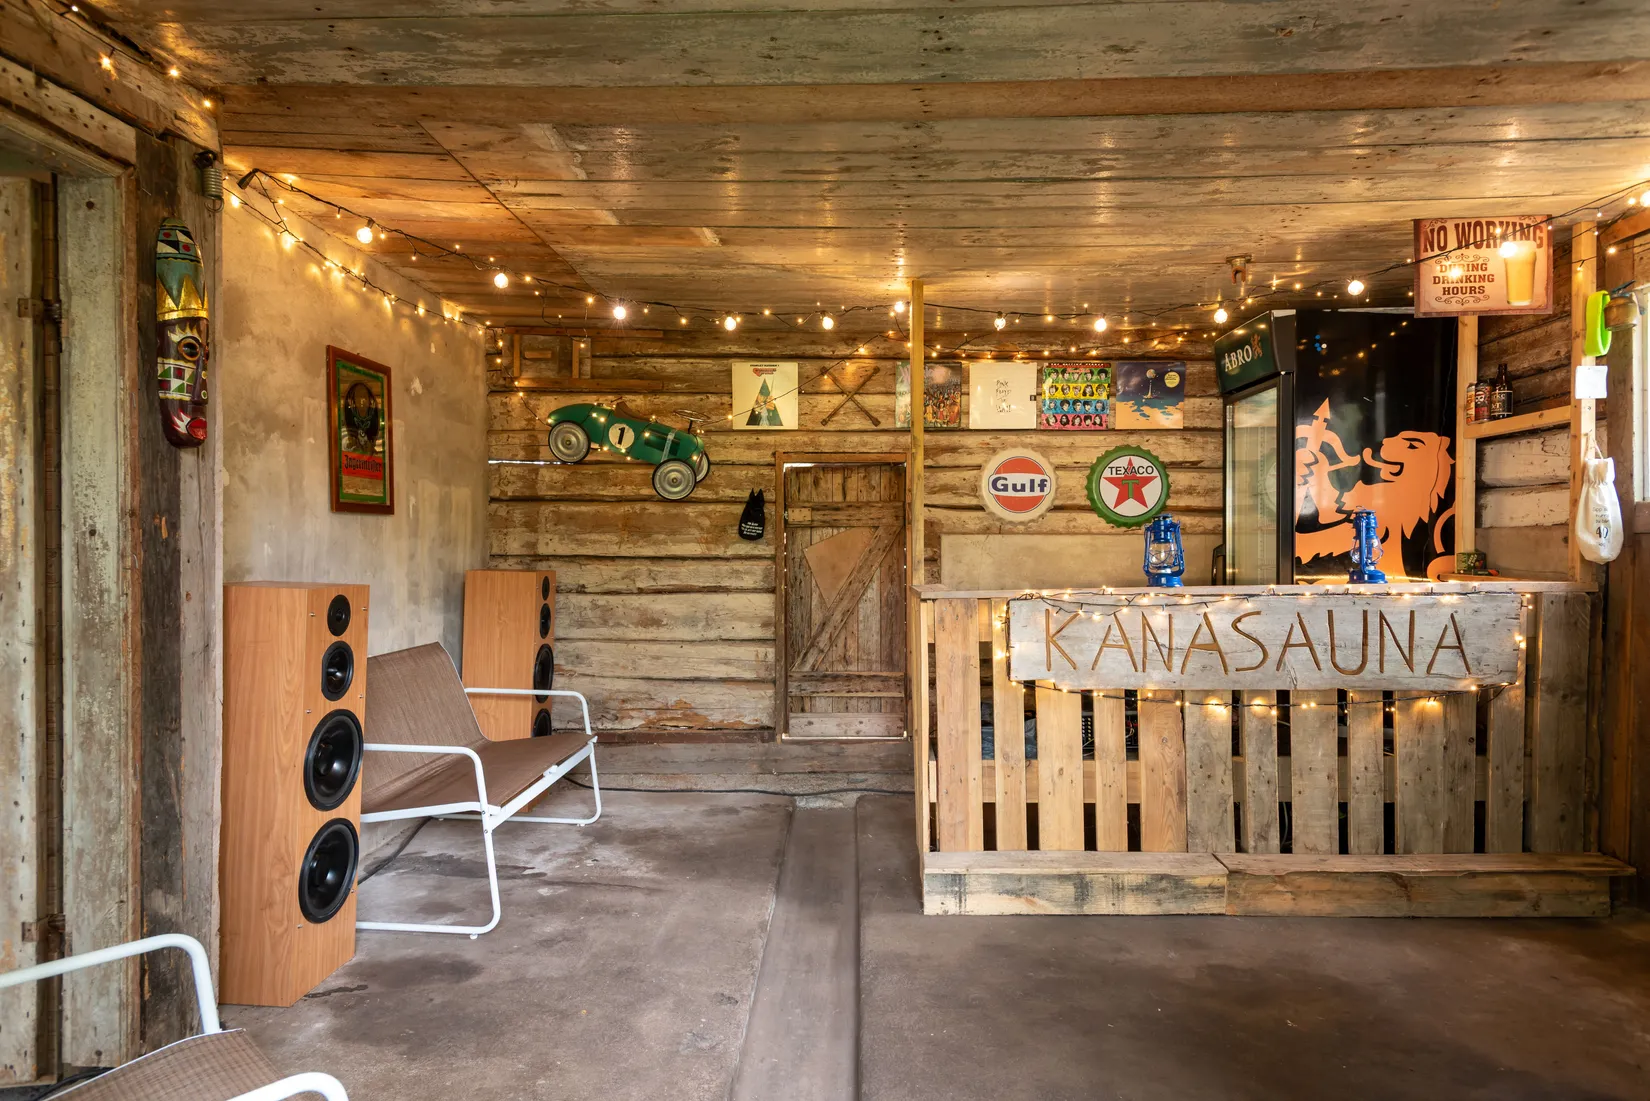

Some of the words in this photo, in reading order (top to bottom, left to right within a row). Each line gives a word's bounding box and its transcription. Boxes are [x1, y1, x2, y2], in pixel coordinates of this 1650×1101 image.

[1422, 224, 1448, 253] NO
[1454, 220, 1544, 250] WORKING
[1442, 285, 1486, 296] HOURS
[1224, 344, 1252, 372] ÅBRO
[618, 426, 626, 445] 1
[1107, 465, 1154, 476] TEXACO
[991, 476, 1048, 493] Gulf
[1121, 479, 1140, 499] T
[1044, 608, 1472, 676] KANASAUNA
